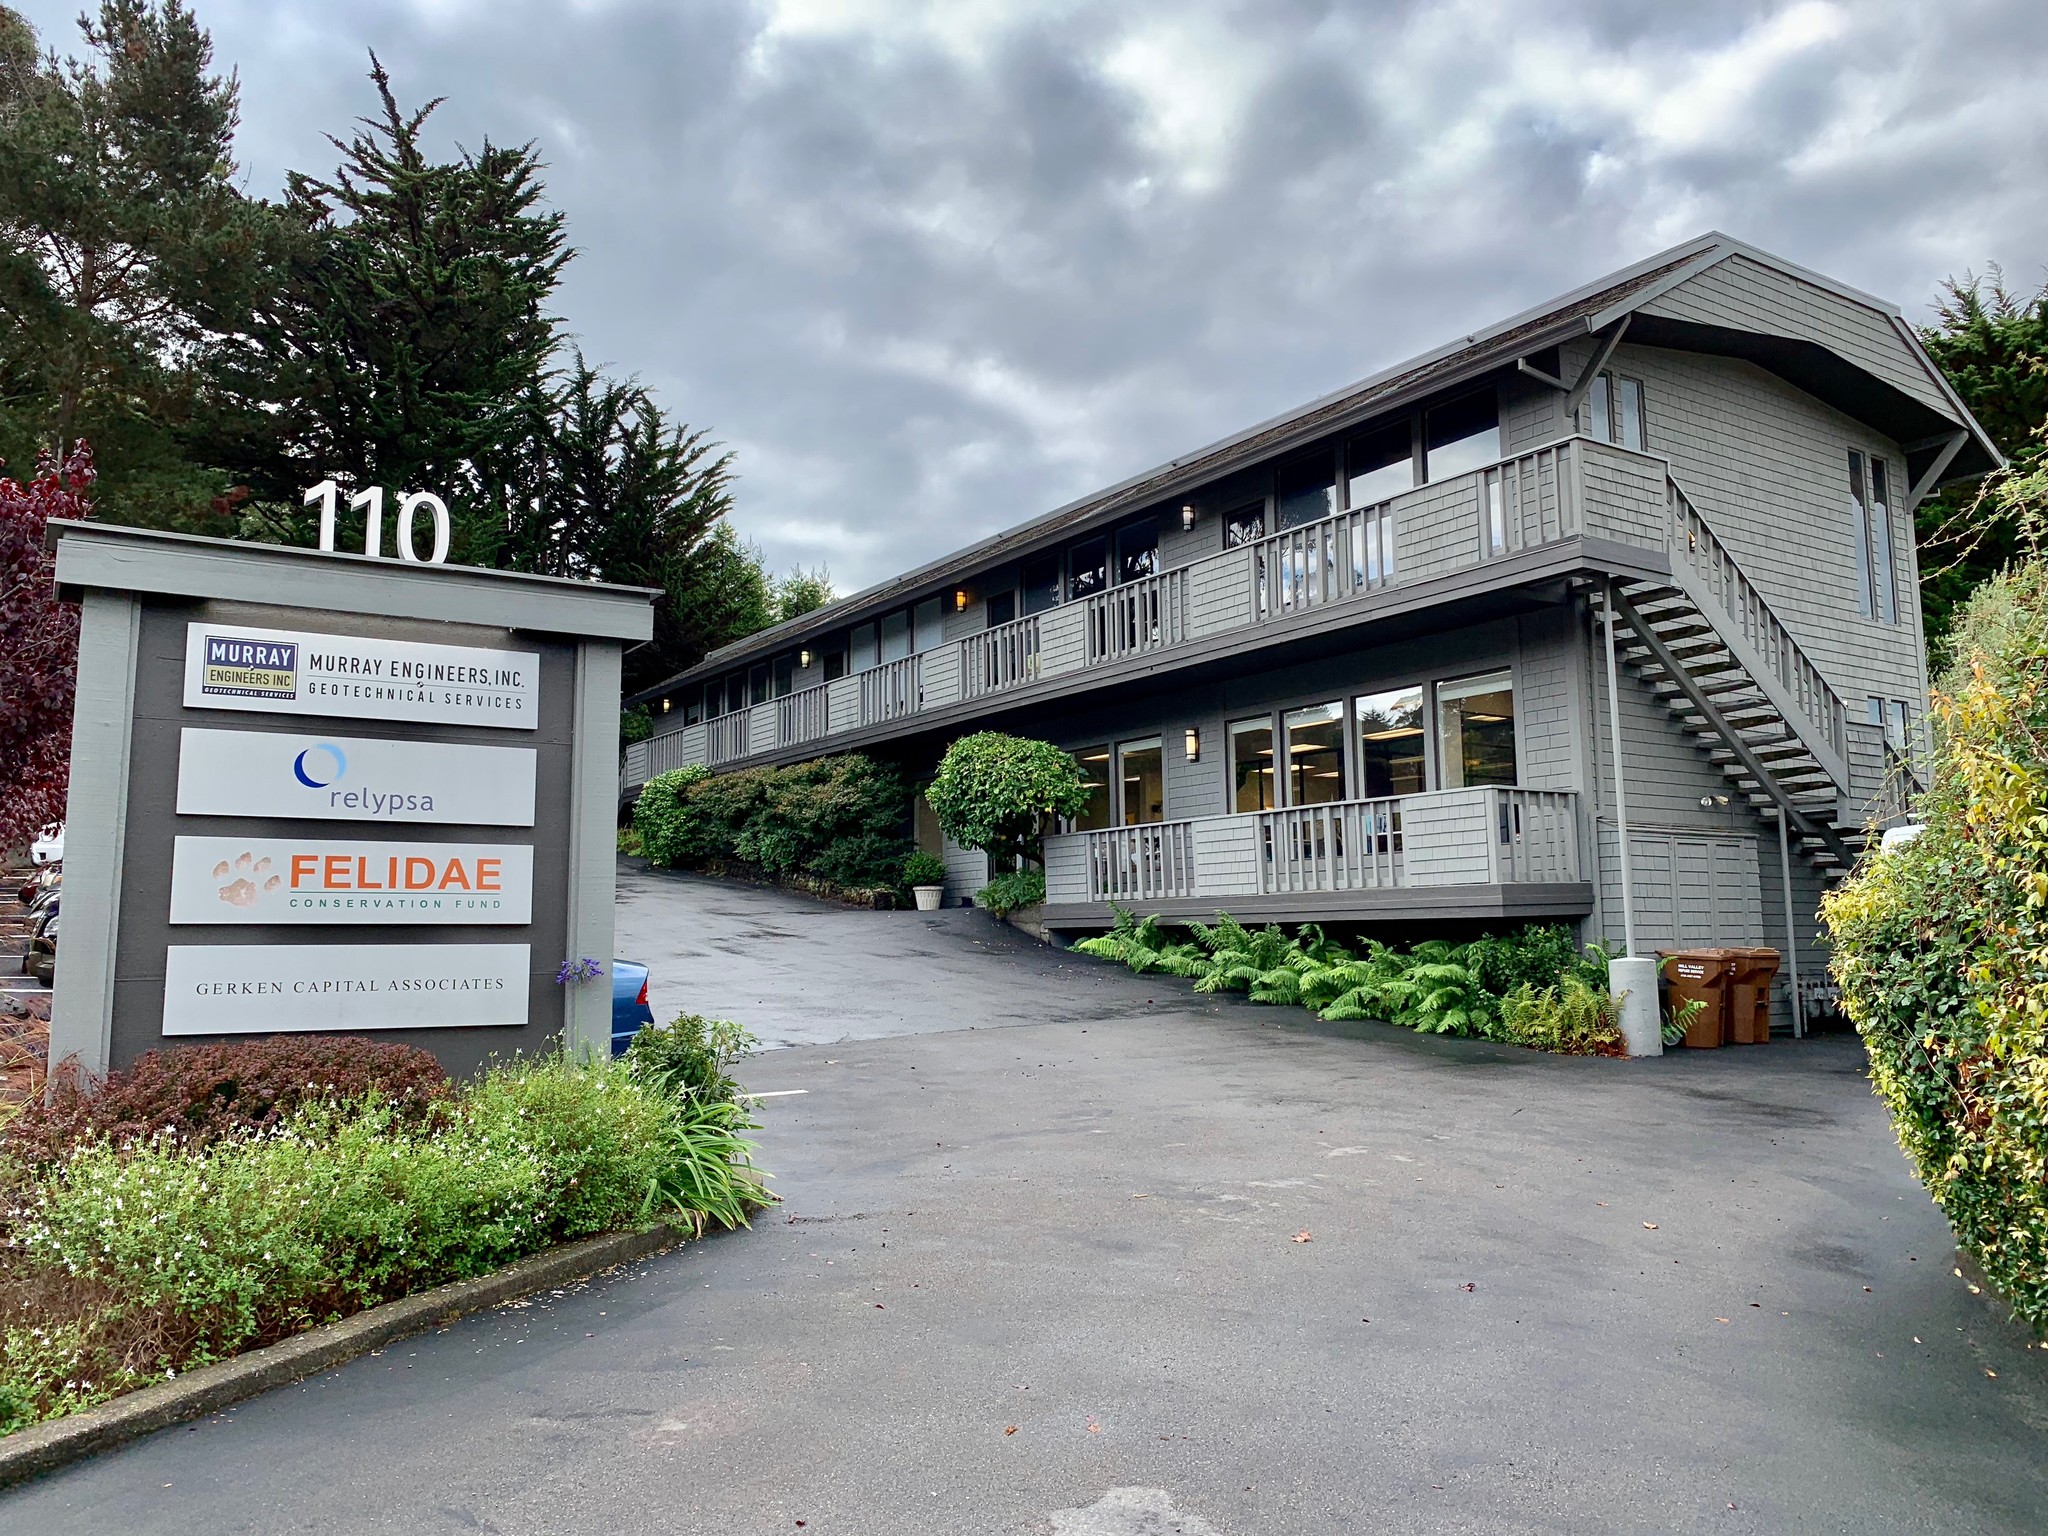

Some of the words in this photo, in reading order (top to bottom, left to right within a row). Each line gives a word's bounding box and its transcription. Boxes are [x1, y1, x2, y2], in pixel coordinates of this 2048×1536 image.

[304, 480, 450, 564] 110
[211, 642, 291, 666] MURRAY
[309, 653, 382, 676] MURRAY
[210, 669, 270, 686] ENGINEERS
[273, 674, 291, 687] INC
[204, 687, 258, 696] GEOTECHNICAL
[260, 691, 295, 699] SERVICES
[309, 682, 435, 703] GEOTECHNICAL
[444, 692, 522, 710] SERVICES
[330, 787, 434, 815] relypsa
[290, 855, 502, 890] FELIDAE
[289, 898, 442, 909] CONSERVATION
[455, 900, 501, 909] FUND
[196, 982, 283, 996] GERKEN
[293, 980, 379, 994] CAPITAL
[387, 978, 504, 991] ASSOCIATES
